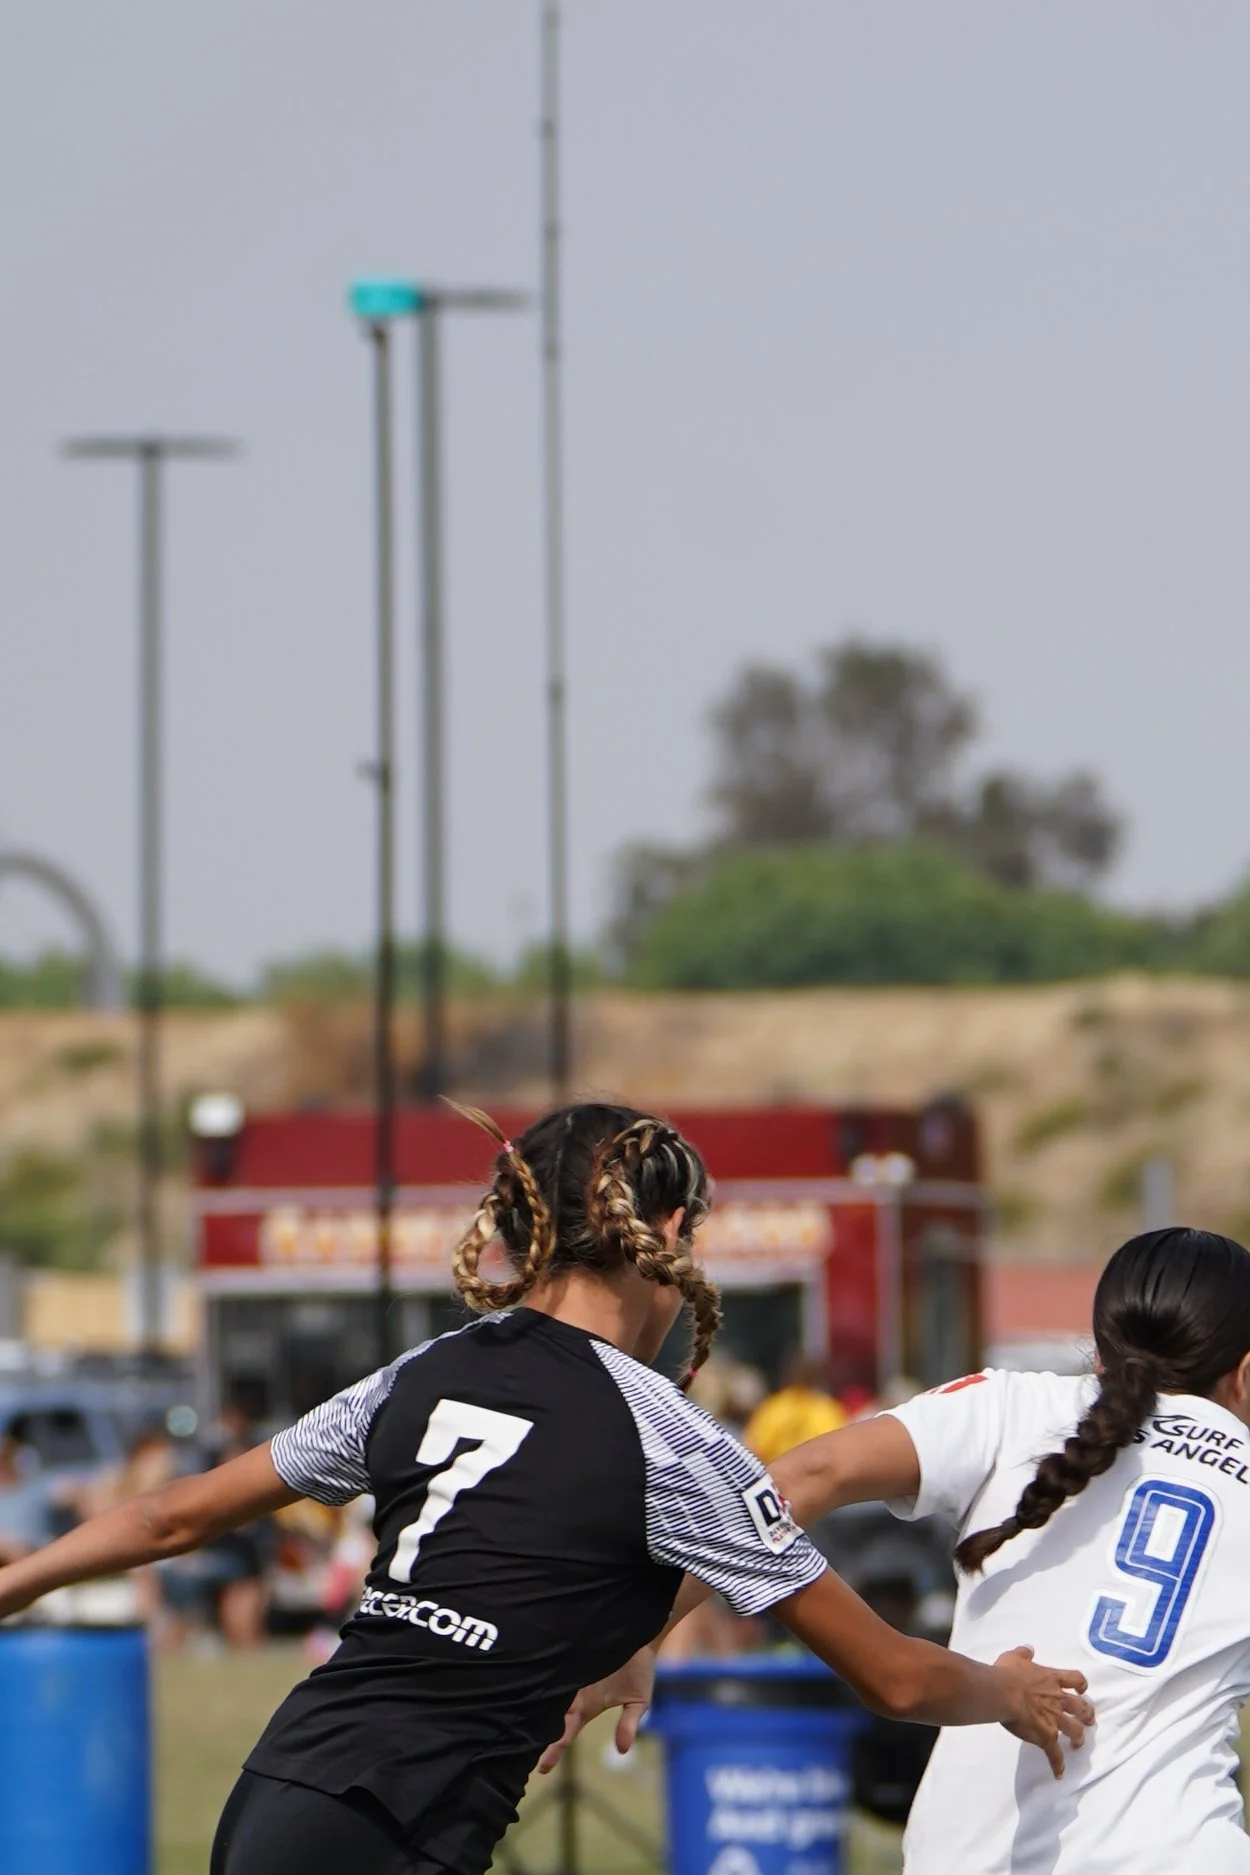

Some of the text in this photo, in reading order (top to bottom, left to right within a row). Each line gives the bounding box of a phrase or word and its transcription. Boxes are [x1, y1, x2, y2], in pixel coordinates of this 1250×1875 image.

[388, 1398, 535, 1584] 7
[1153, 1419, 1246, 1451] SURF
[1086, 1479, 1217, 1670] 9
